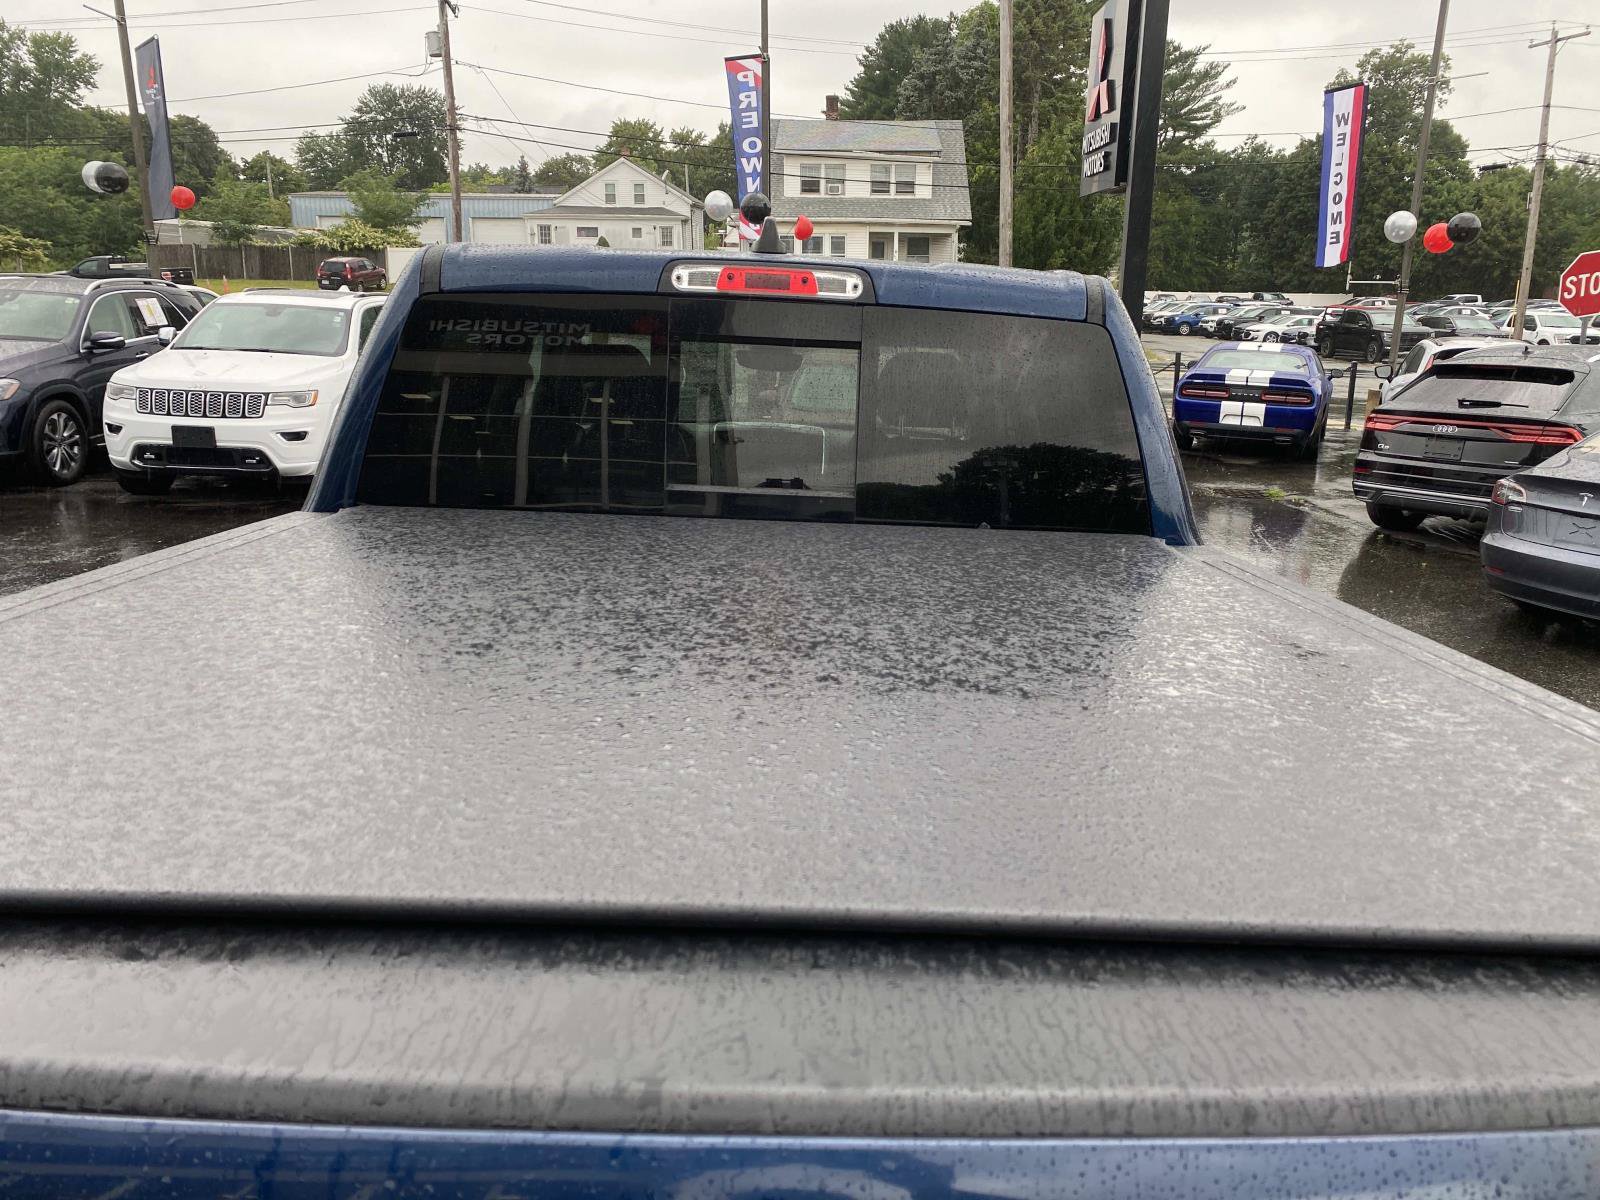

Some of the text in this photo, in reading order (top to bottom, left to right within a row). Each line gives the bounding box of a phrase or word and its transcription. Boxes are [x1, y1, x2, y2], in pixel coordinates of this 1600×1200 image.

[1081, 121, 1110, 155] MITSUBISHI
[1084, 150, 1105, 178] MOTORS
[1563, 271, 1600, 299] STO
